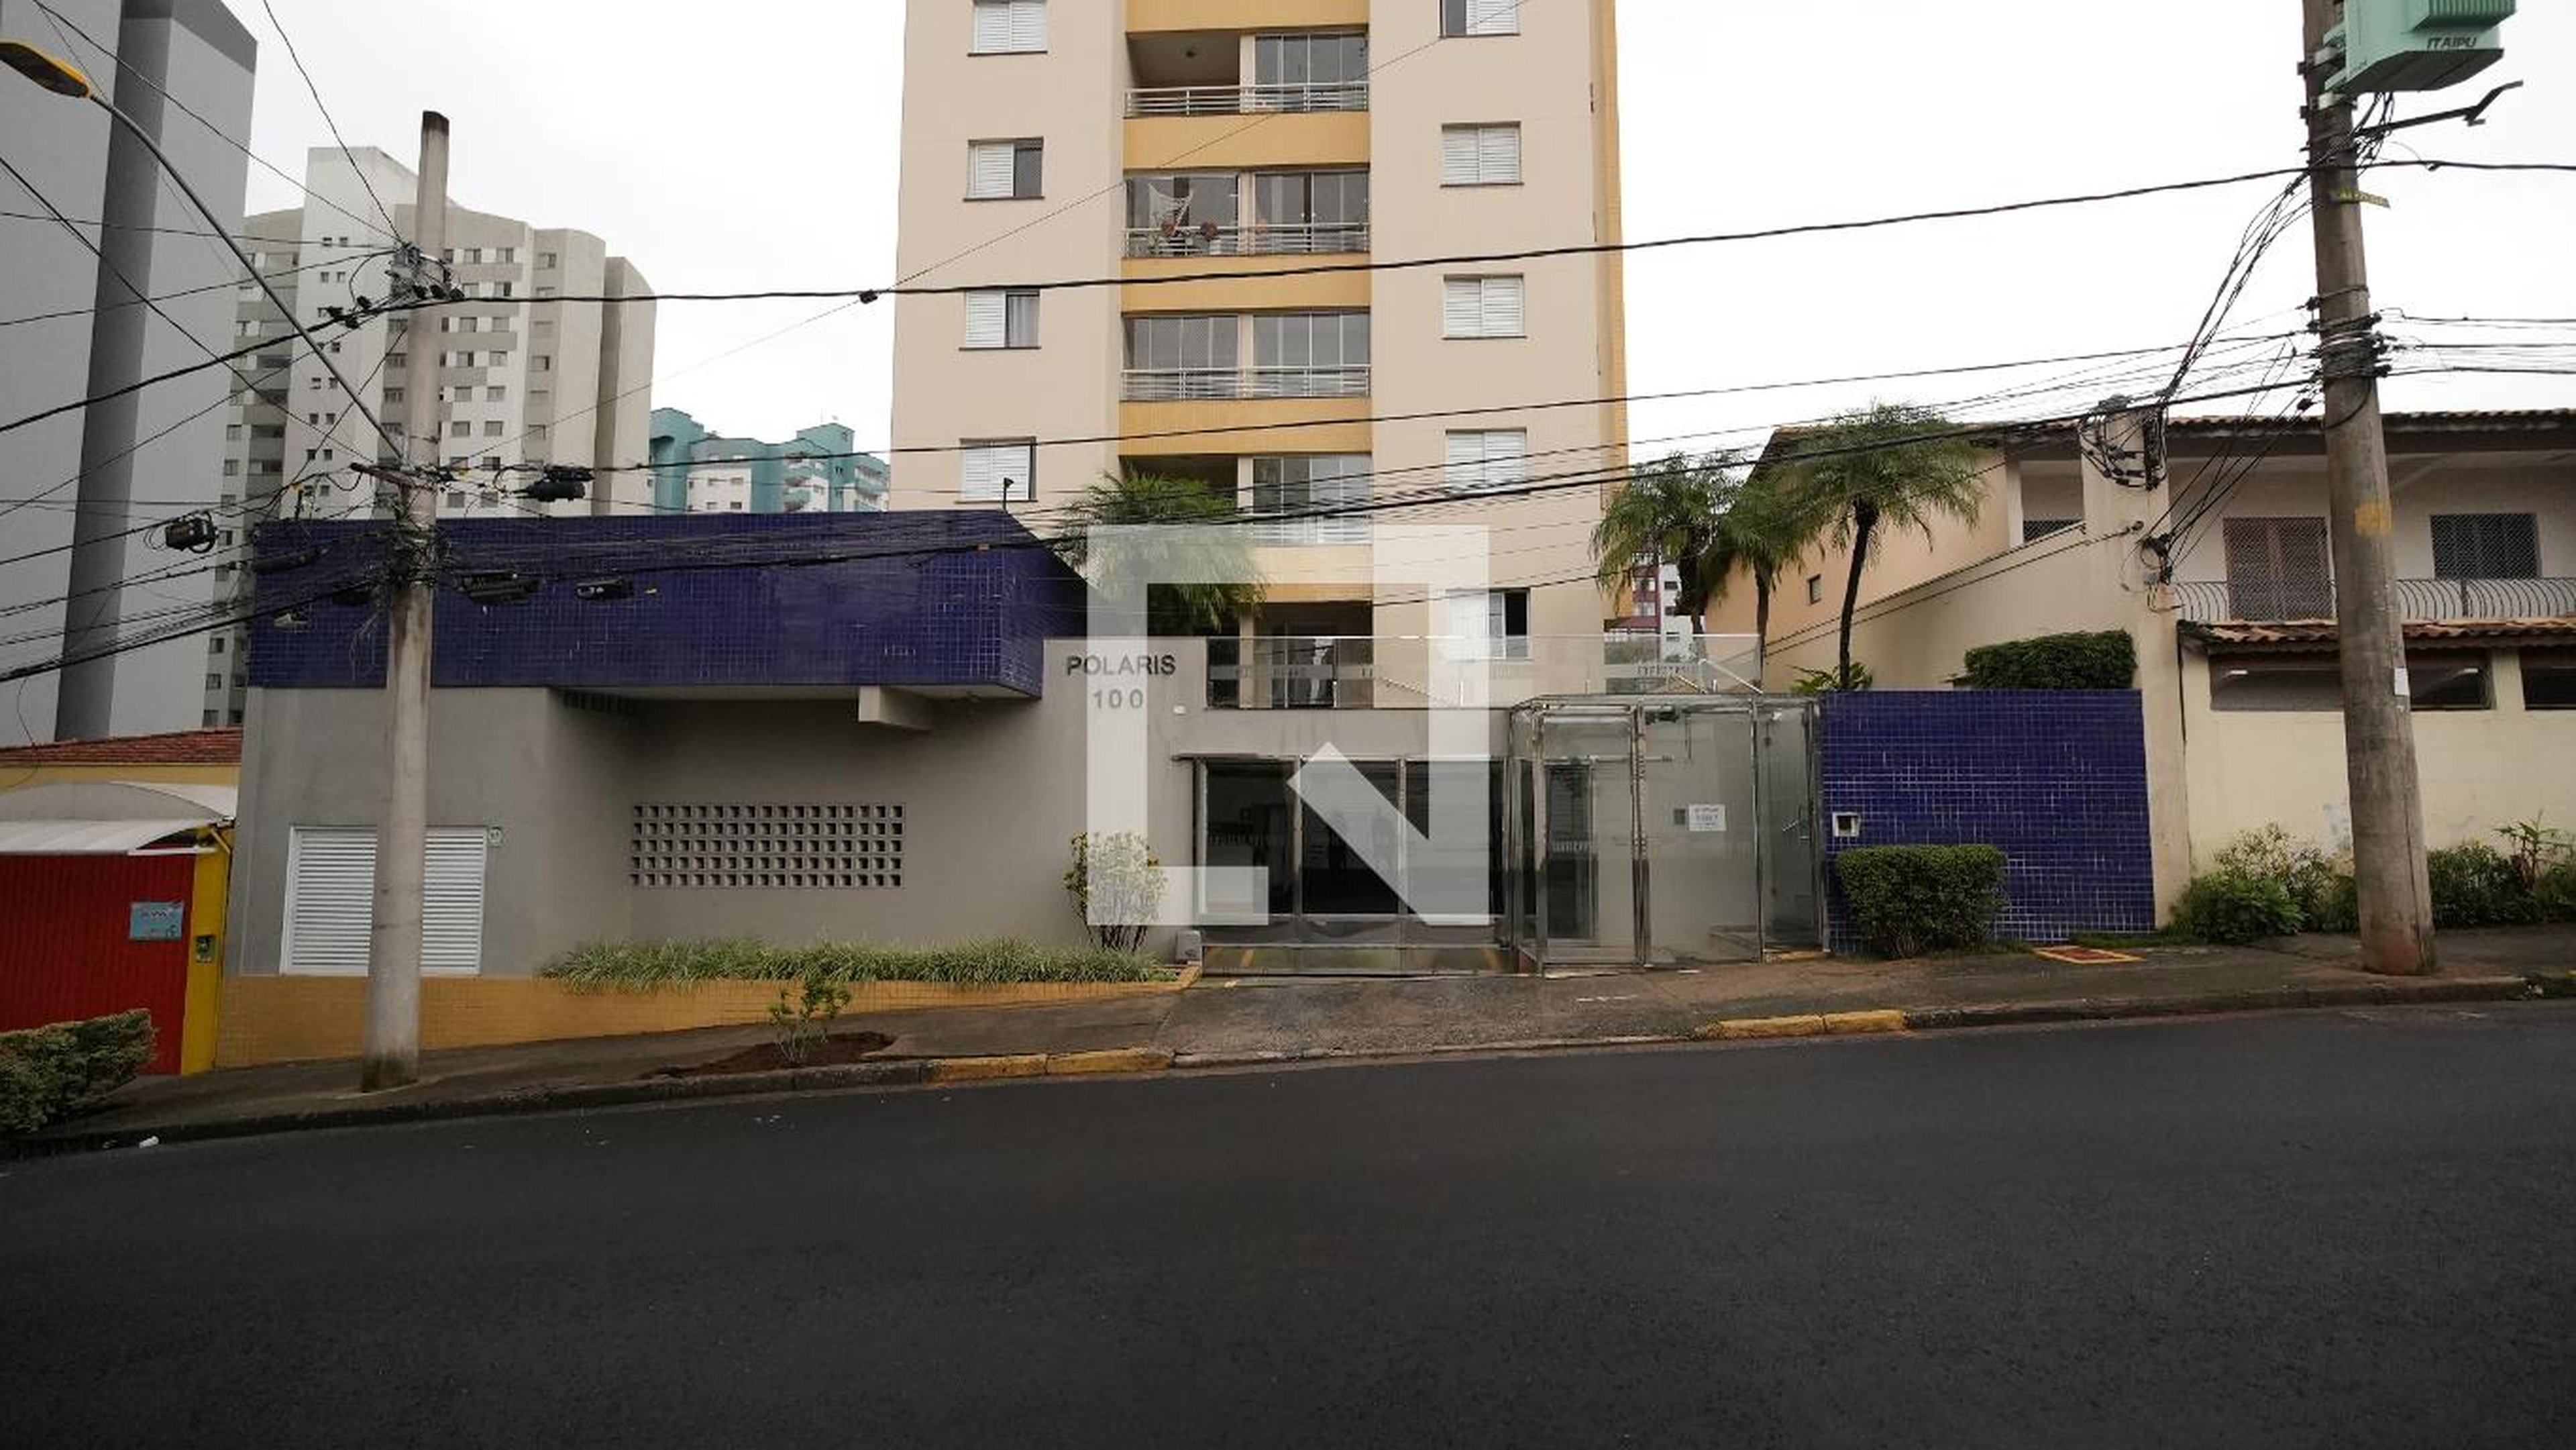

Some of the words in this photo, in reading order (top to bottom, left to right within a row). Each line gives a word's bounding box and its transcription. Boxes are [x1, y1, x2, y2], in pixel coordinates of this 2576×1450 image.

[2427, 36, 2477, 48] ITAIPU
[1067, 655, 1176, 675] POLARIS
[1093, 689, 1143, 709] 100
